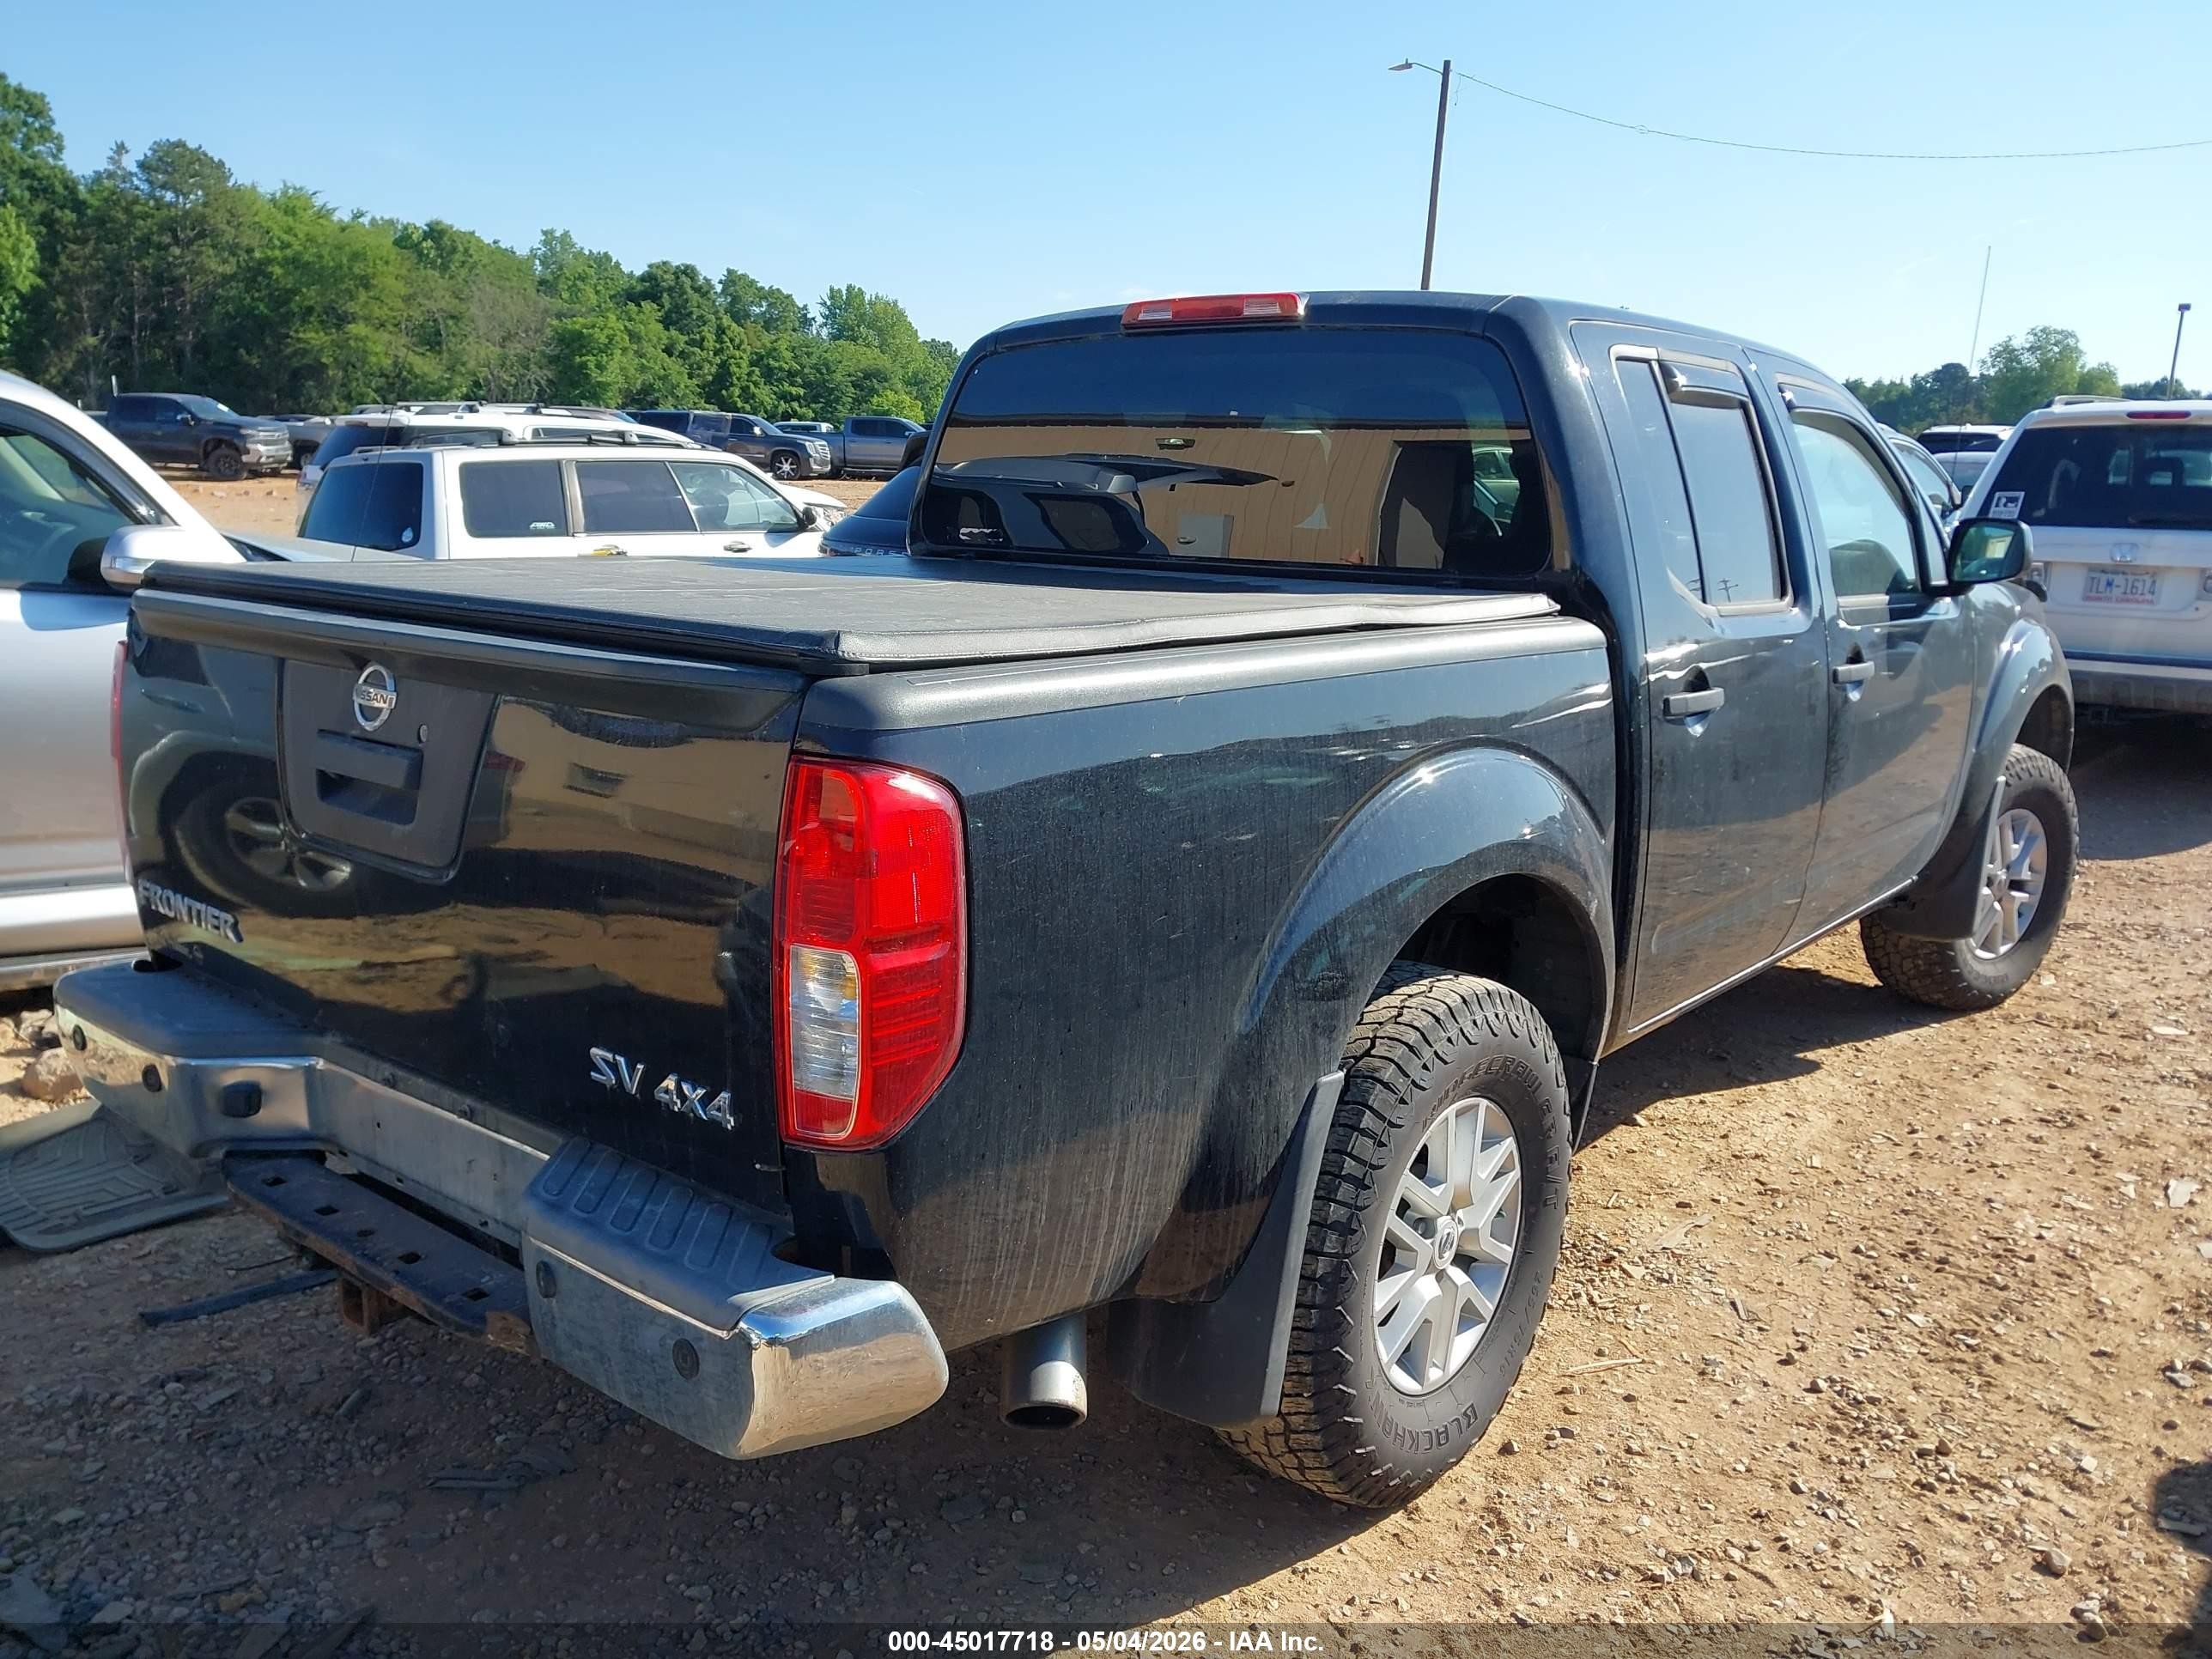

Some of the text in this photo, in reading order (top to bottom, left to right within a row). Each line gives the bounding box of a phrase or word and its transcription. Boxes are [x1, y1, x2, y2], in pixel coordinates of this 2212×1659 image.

[2088, 575, 2157, 596] TLM-1614
[356, 686, 388, 705] SSAN
[138, 878, 237, 943] FRONTIER
[589, 1047, 644, 1095] SV
[1364, 1367, 1479, 1454] BLACKHAWK
